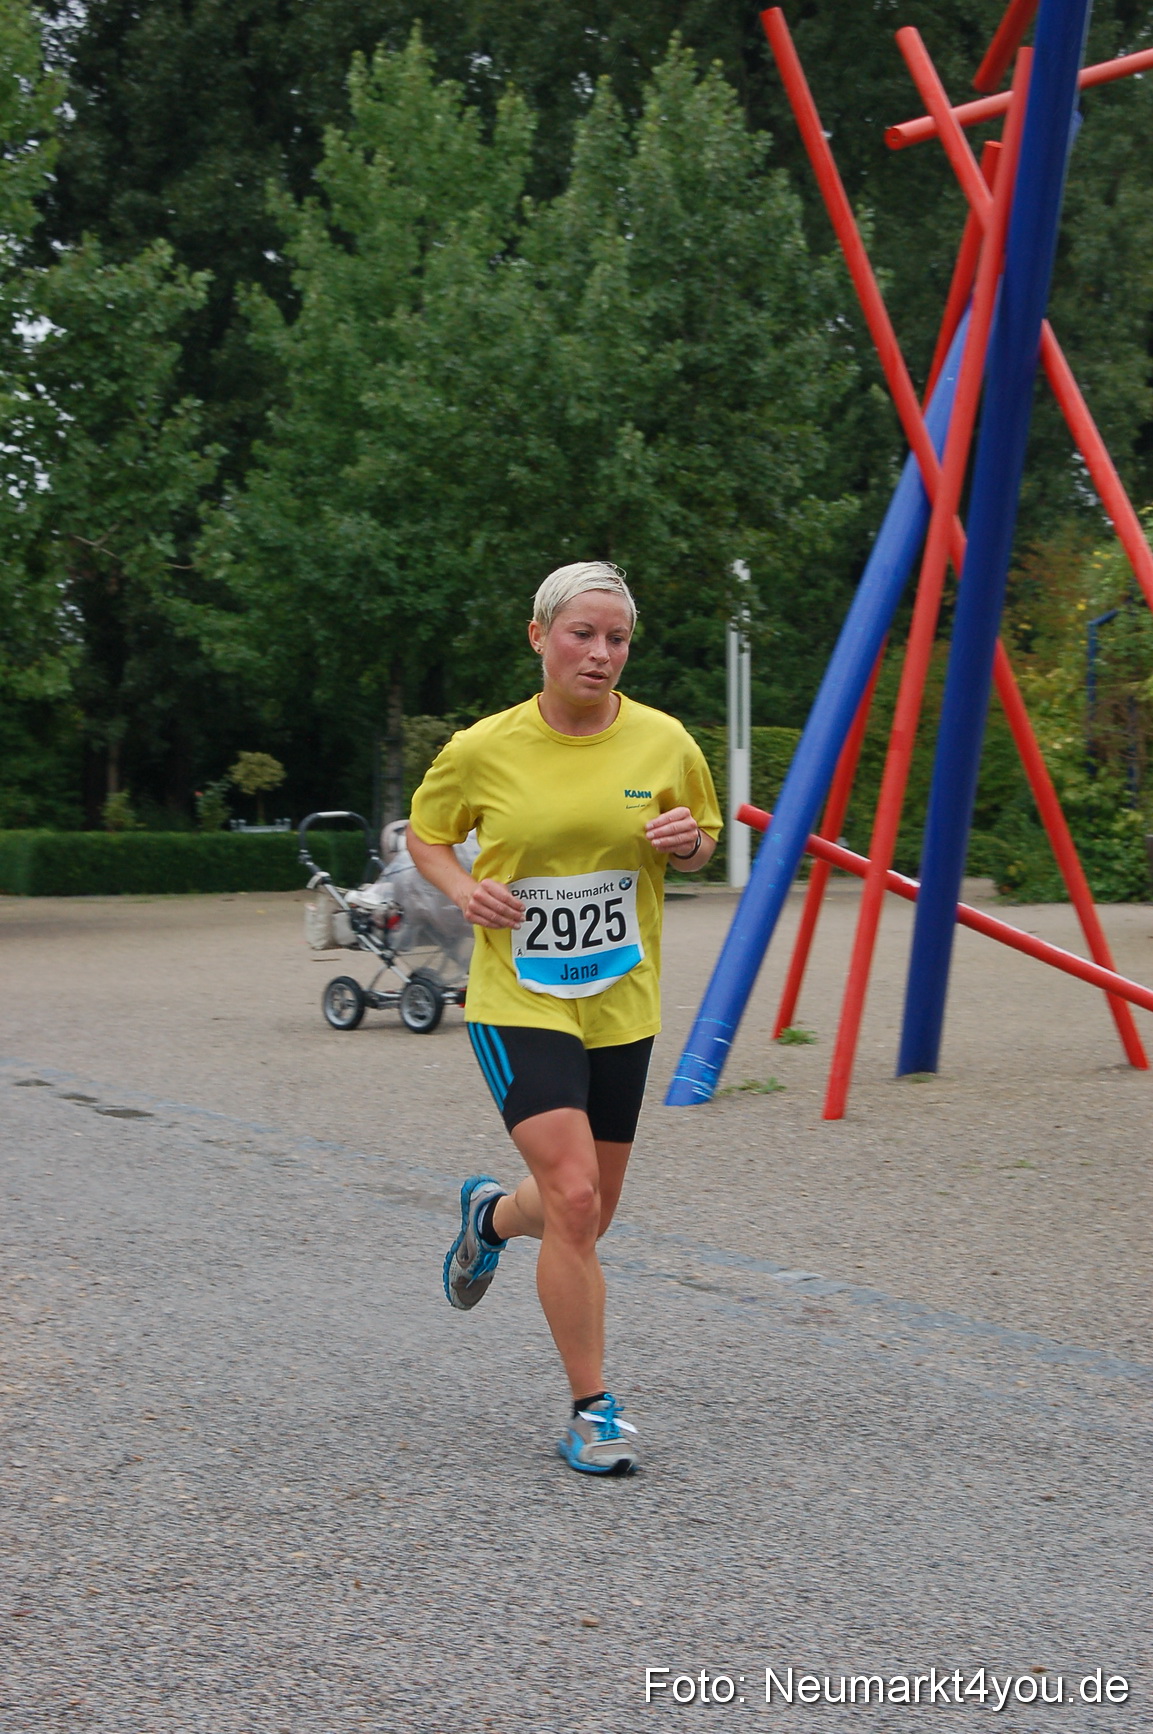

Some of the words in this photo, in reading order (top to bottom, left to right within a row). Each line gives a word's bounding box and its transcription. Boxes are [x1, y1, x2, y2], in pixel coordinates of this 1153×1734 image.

[624, 789, 652, 799] KANN
[511, 889, 553, 900] PARTL
[556, 882, 615, 901] Neumarkt
[525, 897, 627, 951] 2925
[560, 963, 599, 981] Jana
